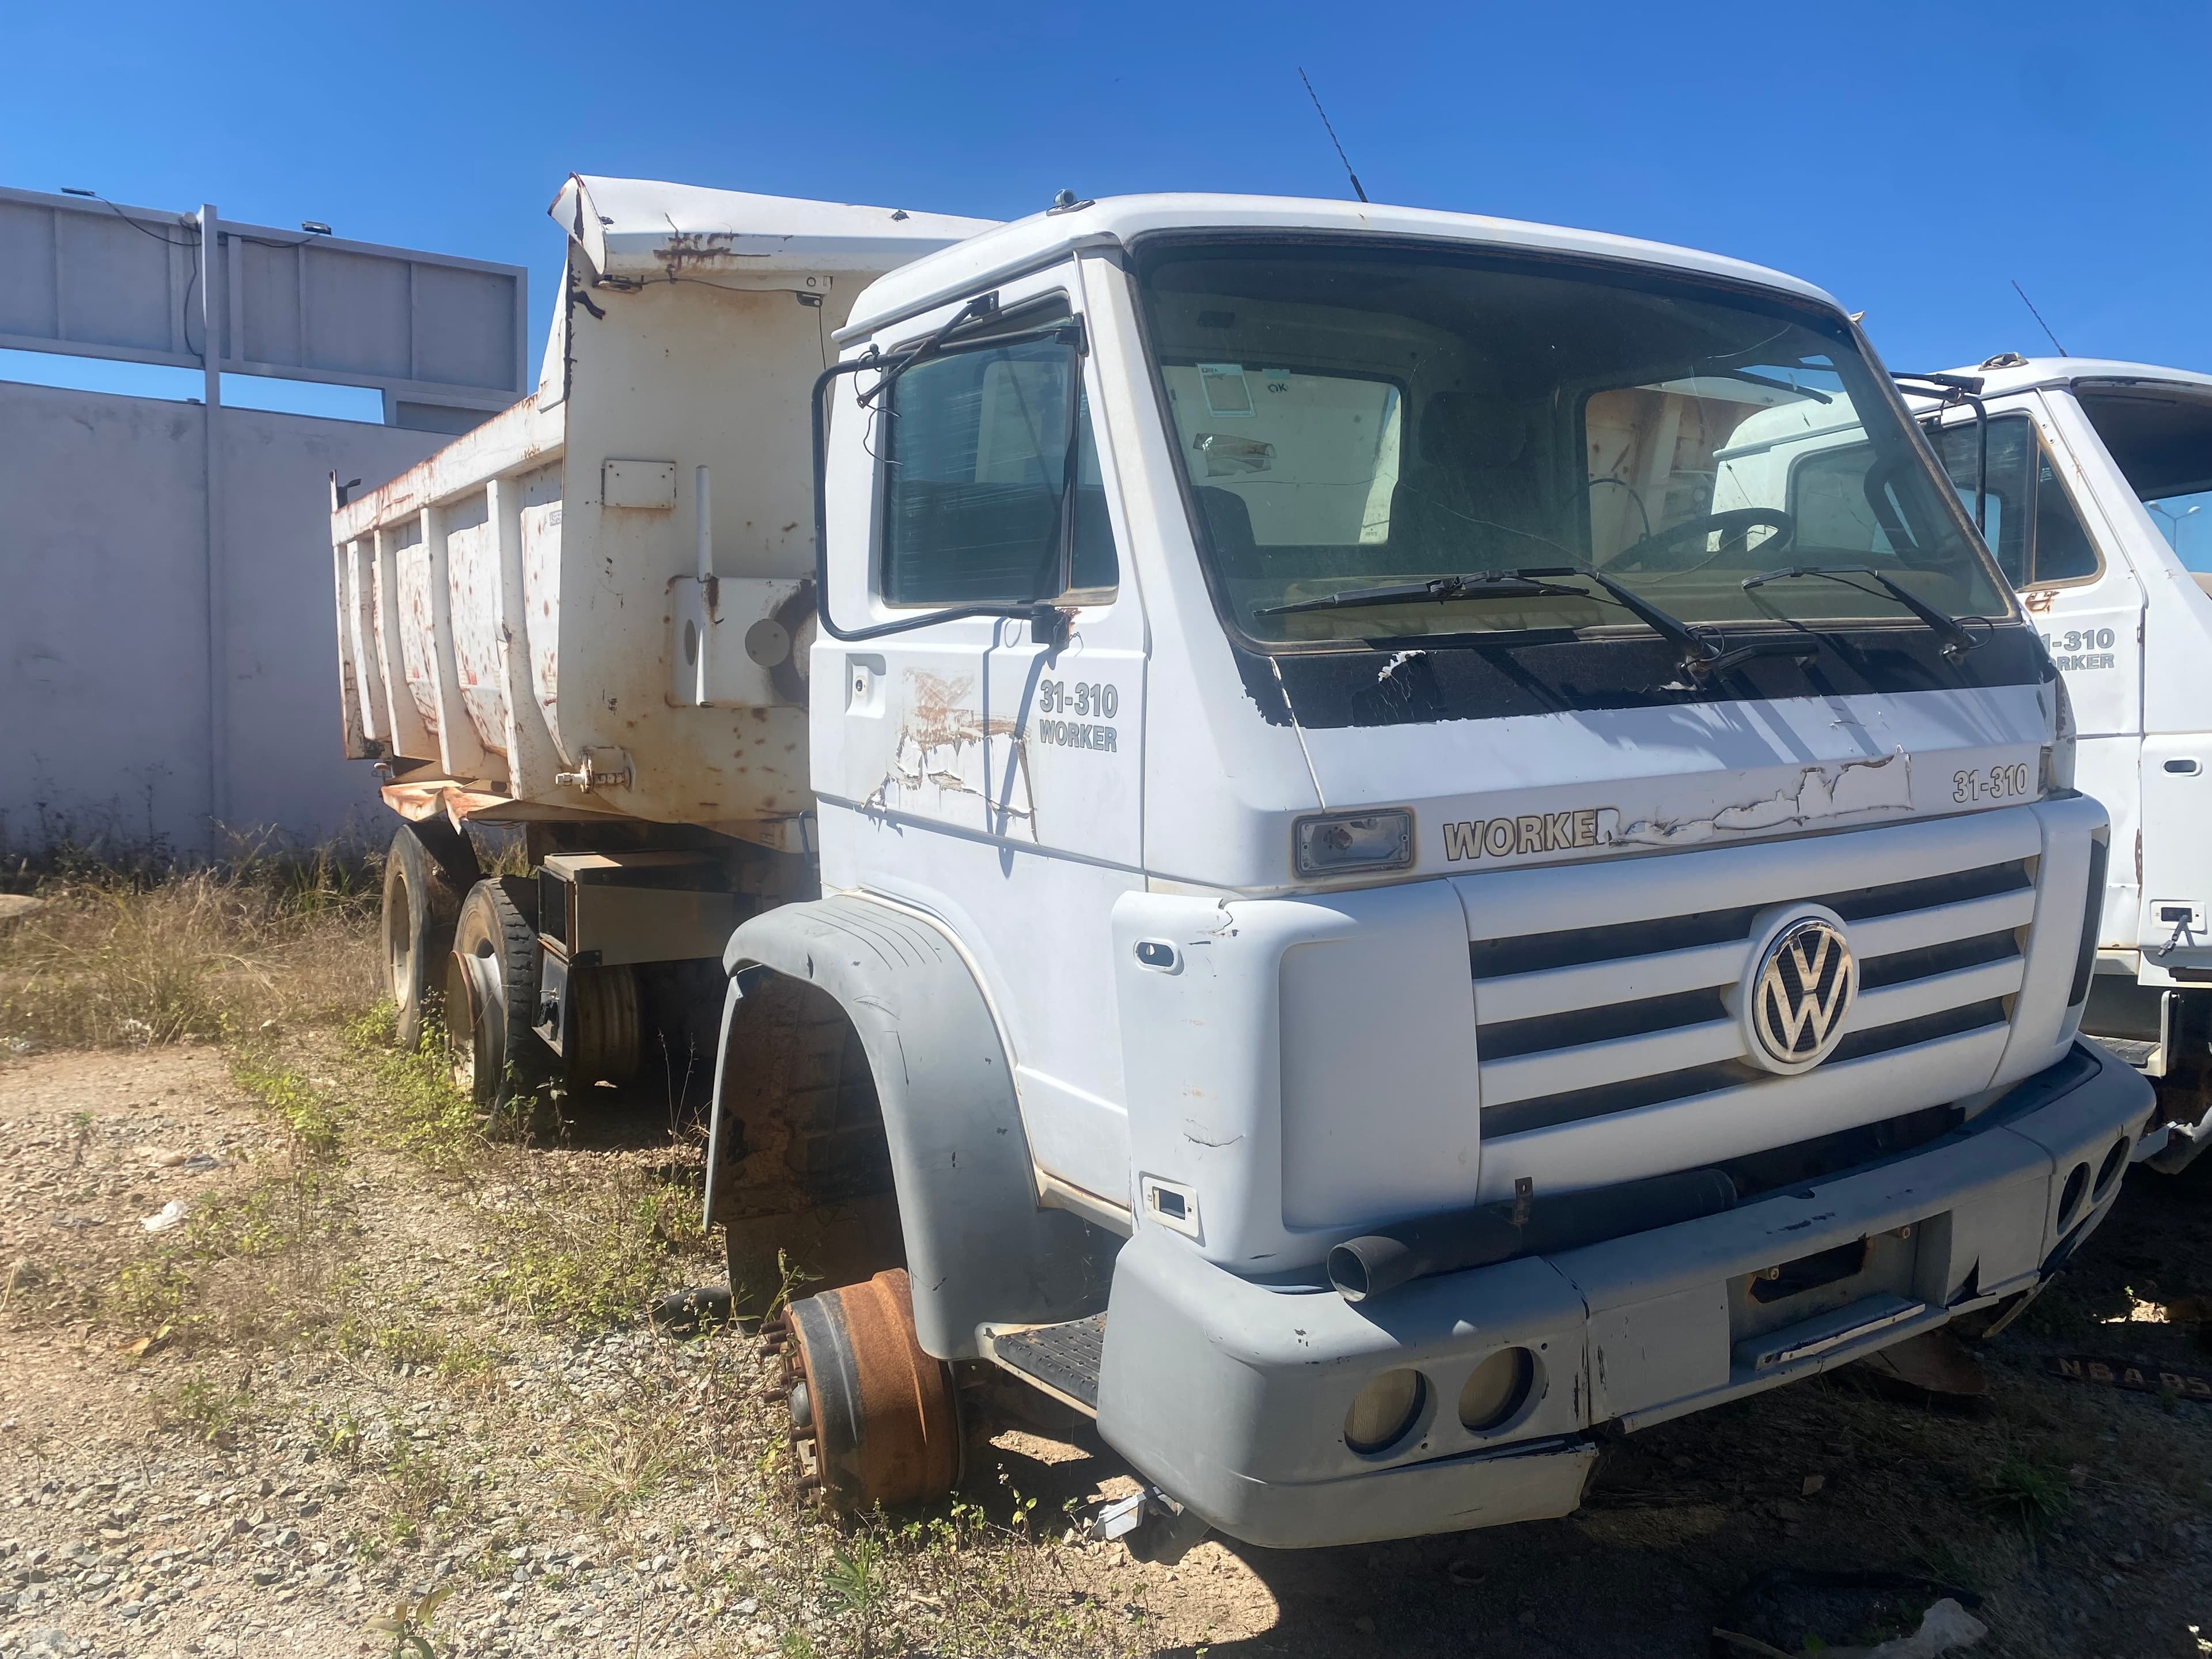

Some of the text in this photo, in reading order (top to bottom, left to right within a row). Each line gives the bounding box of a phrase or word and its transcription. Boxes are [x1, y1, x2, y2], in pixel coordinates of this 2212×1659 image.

[2040, 628, 2115, 653] 1-310
[2051, 653, 2115, 671] RKER
[1039, 679, 1118, 718] 31-310
[1039, 719, 1117, 752] WORKER
[1953, 764, 2029, 803] 31-310
